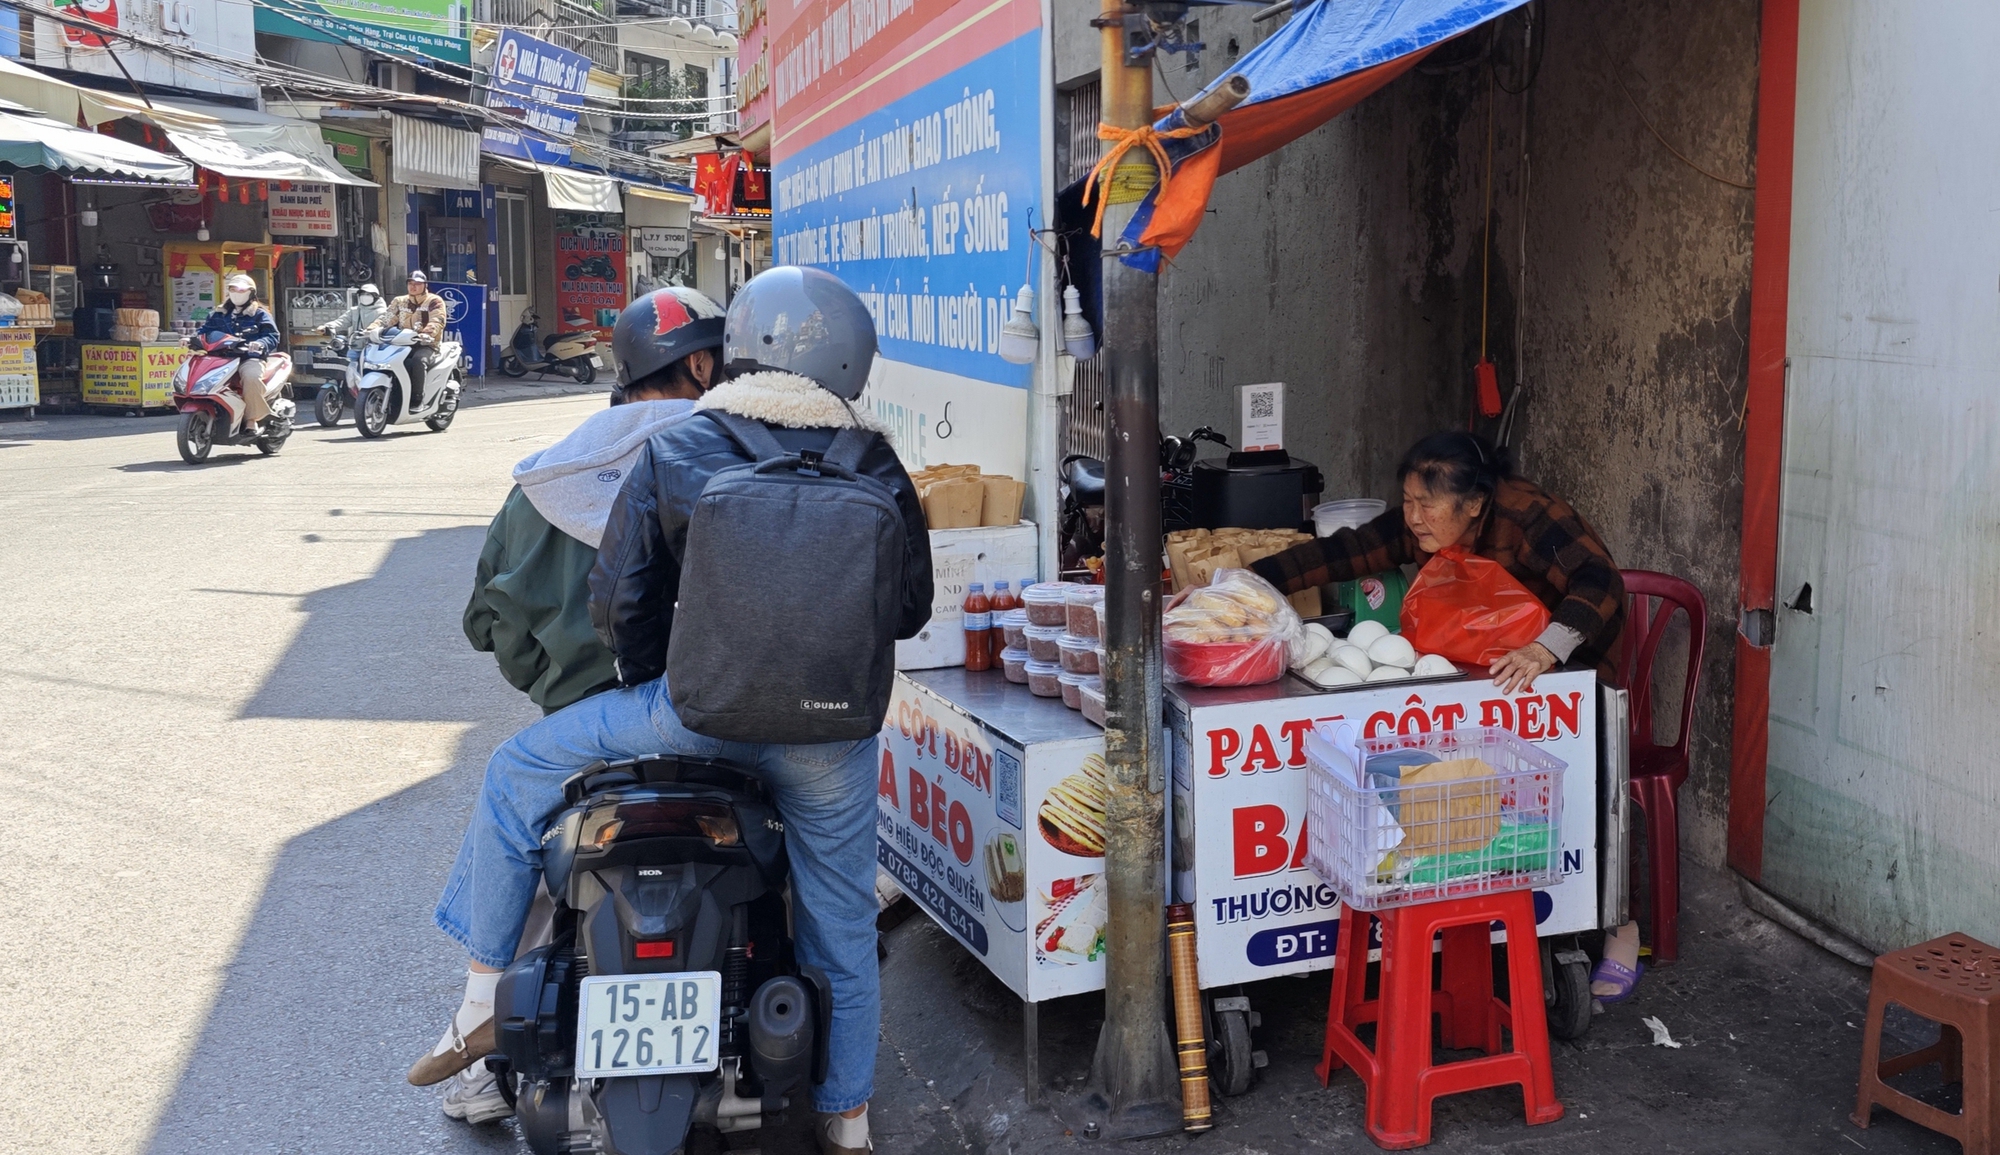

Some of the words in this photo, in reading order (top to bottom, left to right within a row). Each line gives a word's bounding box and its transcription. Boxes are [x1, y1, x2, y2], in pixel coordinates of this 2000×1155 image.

[517, 48, 538, 78] NHÀ
[538, 54, 565, 87] THUỐC
[564, 59, 579, 91] SỐ
[576, 70, 587, 94] 10
[819, 157, 832, 202] QUY
[834, 148, 853, 202] ĐỊNH
[854, 129, 865, 188] VỀ
[867, 137, 881, 184] AN
[882, 119, 910, 179] TOÀN
[912, 111, 942, 171] GIAO
[944, 86, 1000, 160] THÔNG,
[560, 237, 578, 254] DỊCH
[581, 238, 590, 254] VỤ
[830, 215, 840, 271] VỆ
[841, 219, 861, 262] SINH
[863, 206, 881, 260] MÔI
[882, 199, 930, 263] TRƯỜNG,
[932, 185, 960, 255] NẾP
[964, 174, 1009, 254] SỐNG
[561, 280, 575, 292] MUA
[577, 279, 588, 292] BÁN
[606, 282, 623, 297] THOẠI
[888, 278, 910, 341] CỦA
[912, 276, 935, 345] MỖI
[938, 283, 982, 352] NGƯỜI
[899, 698, 939, 759] CỘT
[944, 729, 992, 798] ĐÈN
[1206, 714, 1345, 780] PAT
[878, 737, 900, 811] À
[908, 766, 974, 866] BÉO
[888, 853, 918, 890] 0788
[922, 880, 946, 915] 424
[950, 907, 974, 941] 641
[896, 825, 918, 858] HIỆU
[920, 845, 945, 879] ĐỘC
[946, 874, 985, 916] QUYỀN
[1212, 882, 1338, 923] THƯƠNG
[1275, 930, 1327, 958] ĐT:
[606, 981, 699, 1024] 15-AB
[591, 1025, 710, 1069] 126.12
